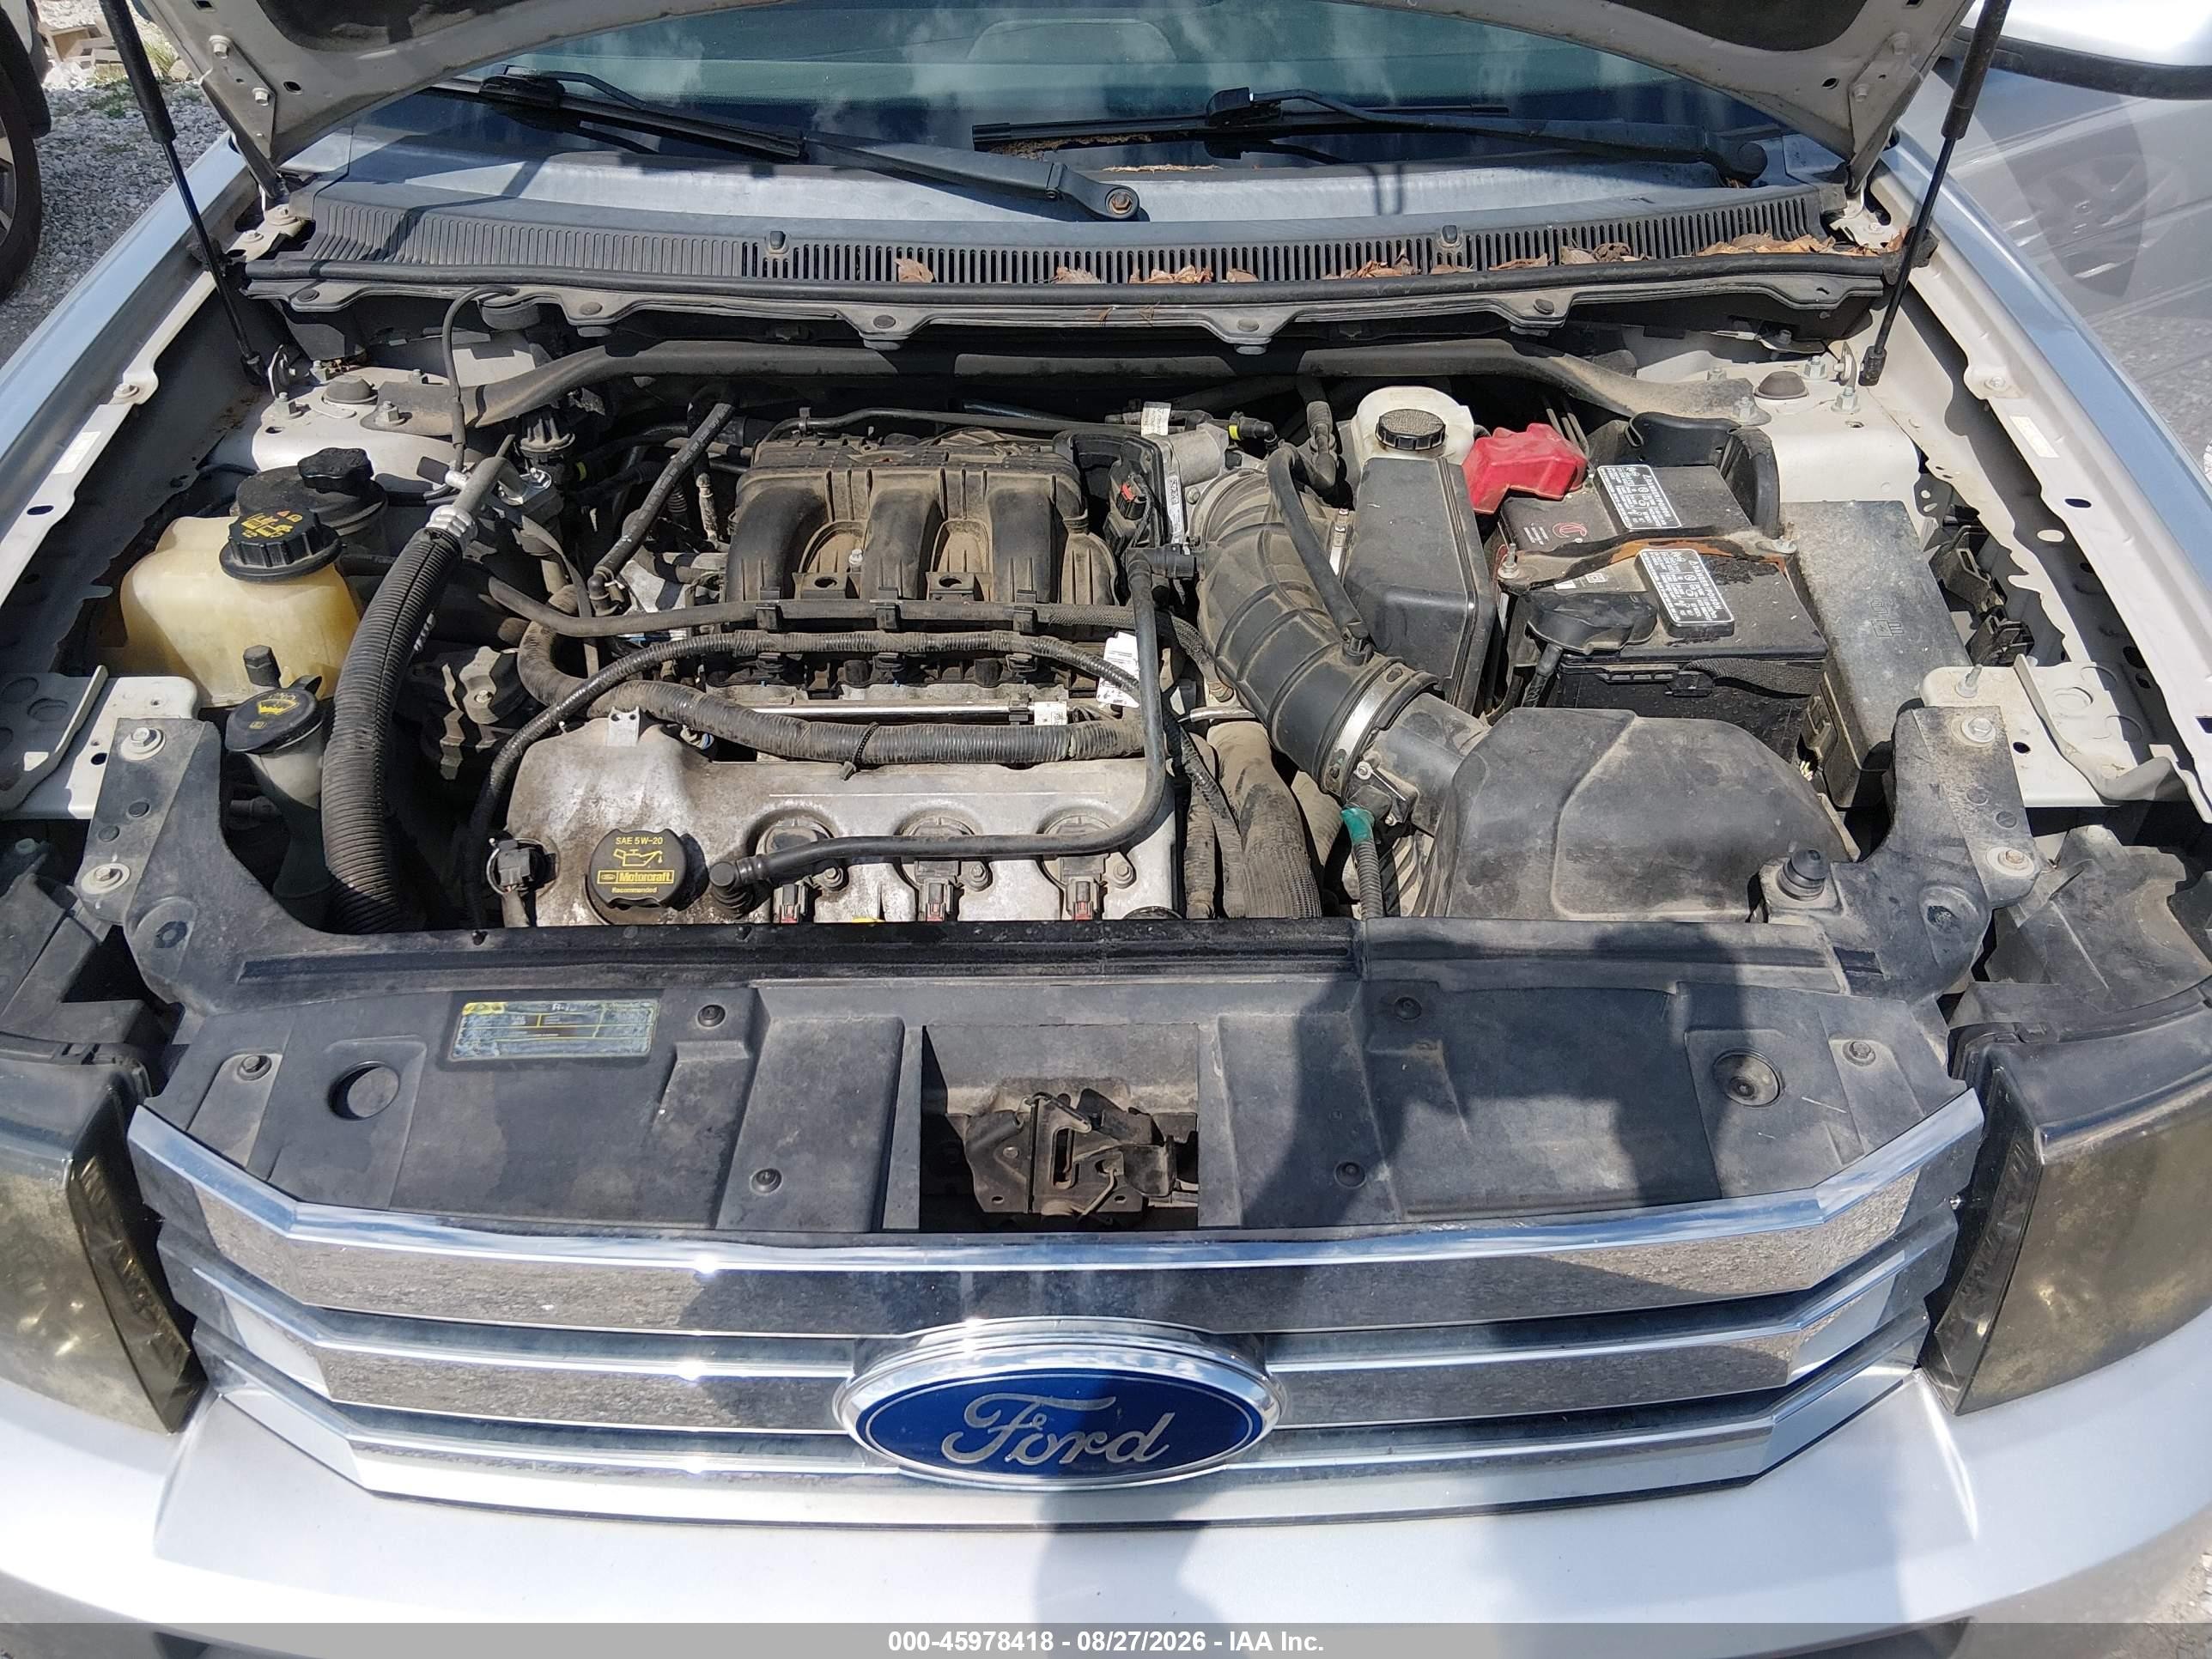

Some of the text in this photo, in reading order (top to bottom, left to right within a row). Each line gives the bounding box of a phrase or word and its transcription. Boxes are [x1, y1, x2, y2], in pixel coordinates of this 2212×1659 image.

[615, 836, 664, 845] SAE 5W-20
[618, 872, 672, 882] Motorcraft
[941, 1393, 1176, 1466] Ford
